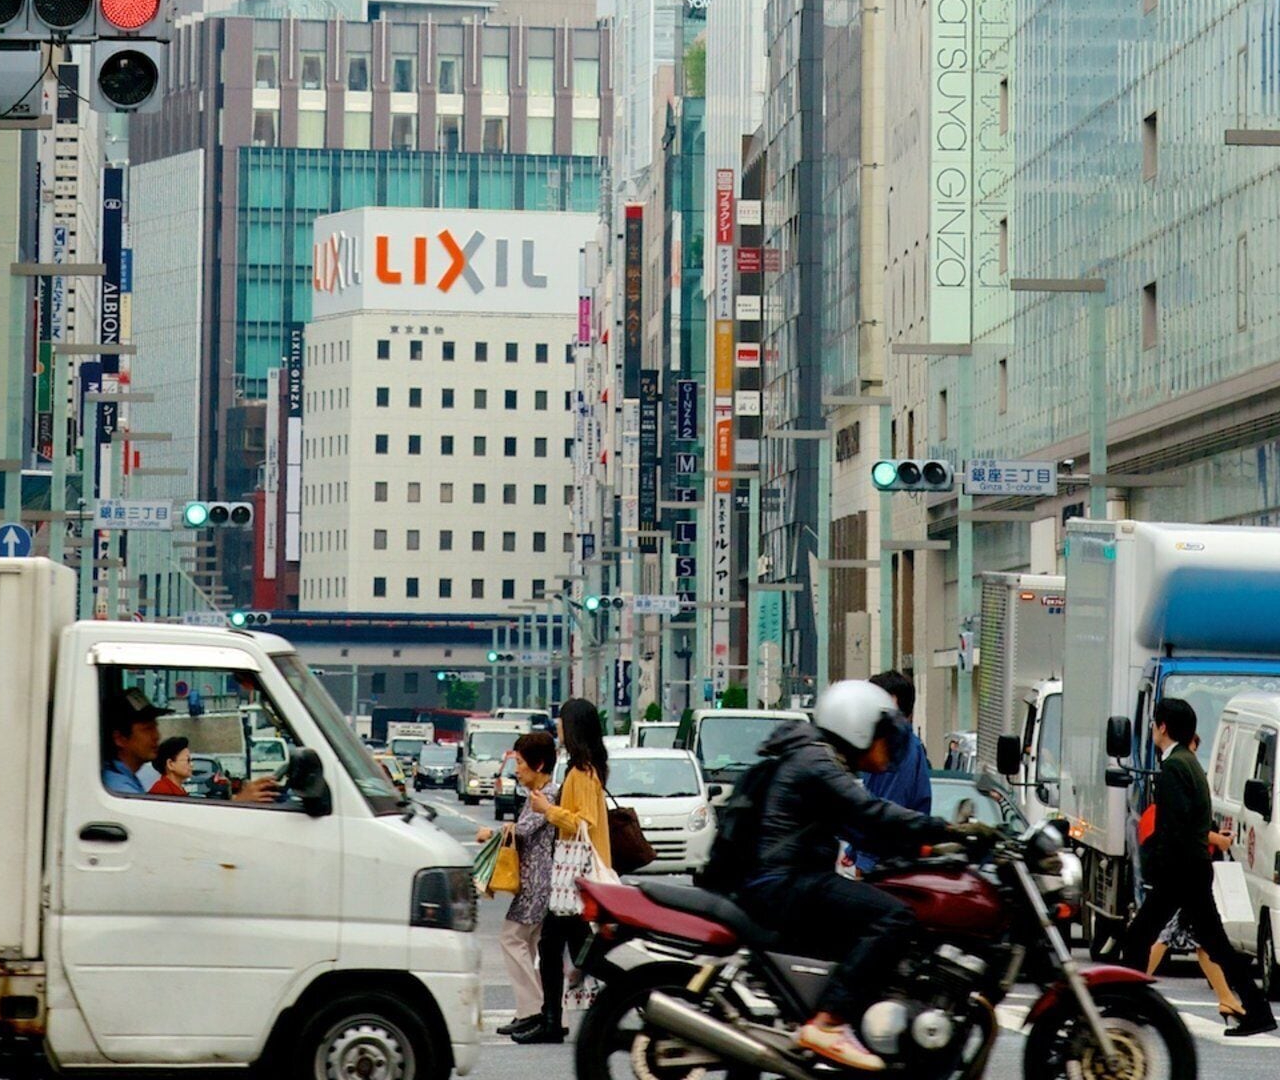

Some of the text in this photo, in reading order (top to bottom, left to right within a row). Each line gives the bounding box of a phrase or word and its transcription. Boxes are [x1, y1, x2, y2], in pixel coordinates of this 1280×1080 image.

[376, 229, 548, 294] LIXIL
[972, 469, 1050, 482] 銀座三丁目
[100, 506, 168, 520] 銀座三丁目
